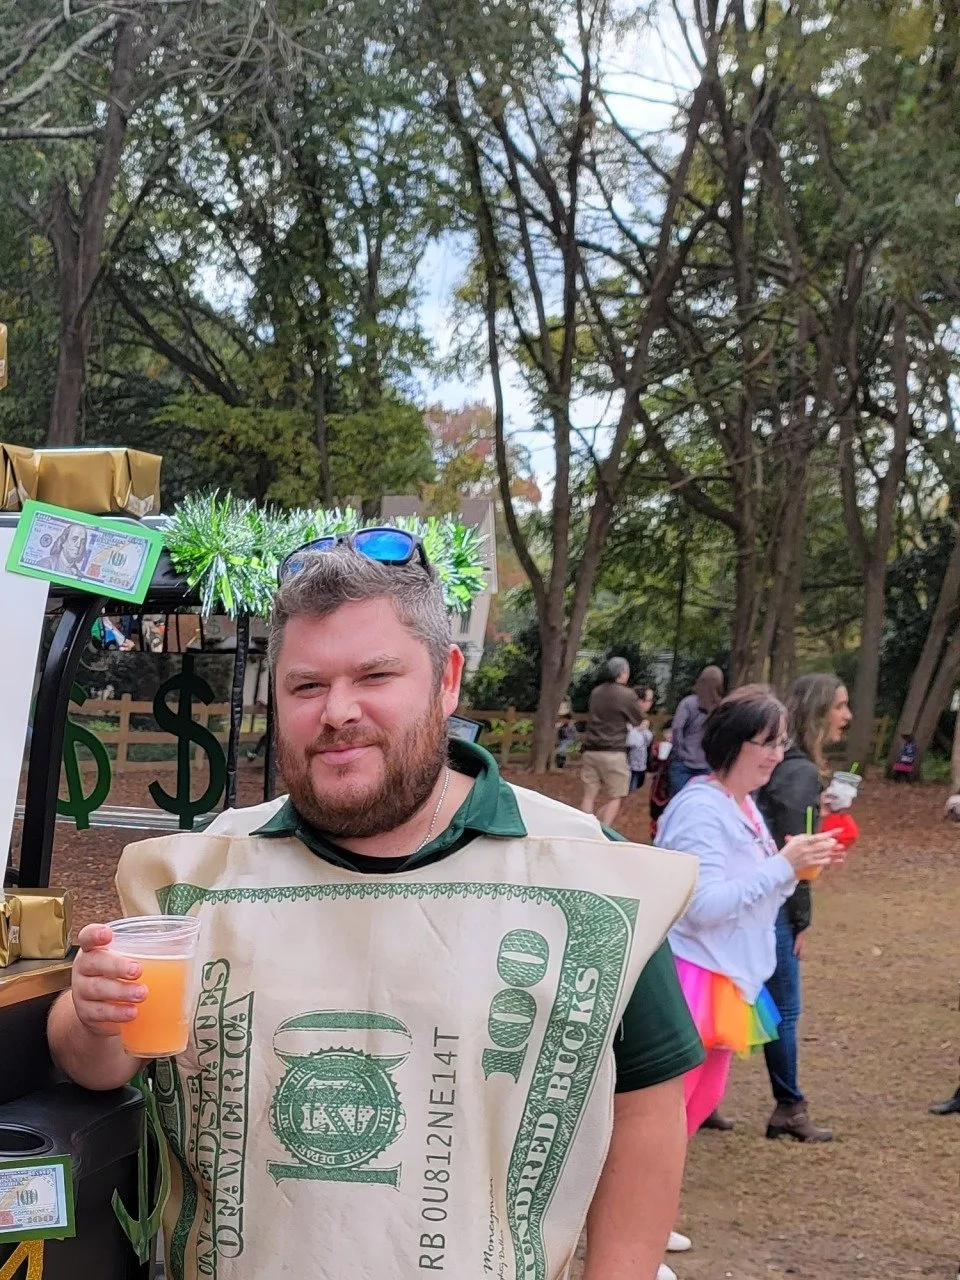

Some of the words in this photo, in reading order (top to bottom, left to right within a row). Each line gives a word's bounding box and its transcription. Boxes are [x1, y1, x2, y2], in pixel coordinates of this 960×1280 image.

[481, 929, 550, 1084] 100
[545, 967, 600, 1102] BUCKS
[216, 991, 255, 1205] AMERICA
[418, 1233, 446, 1272] RB
